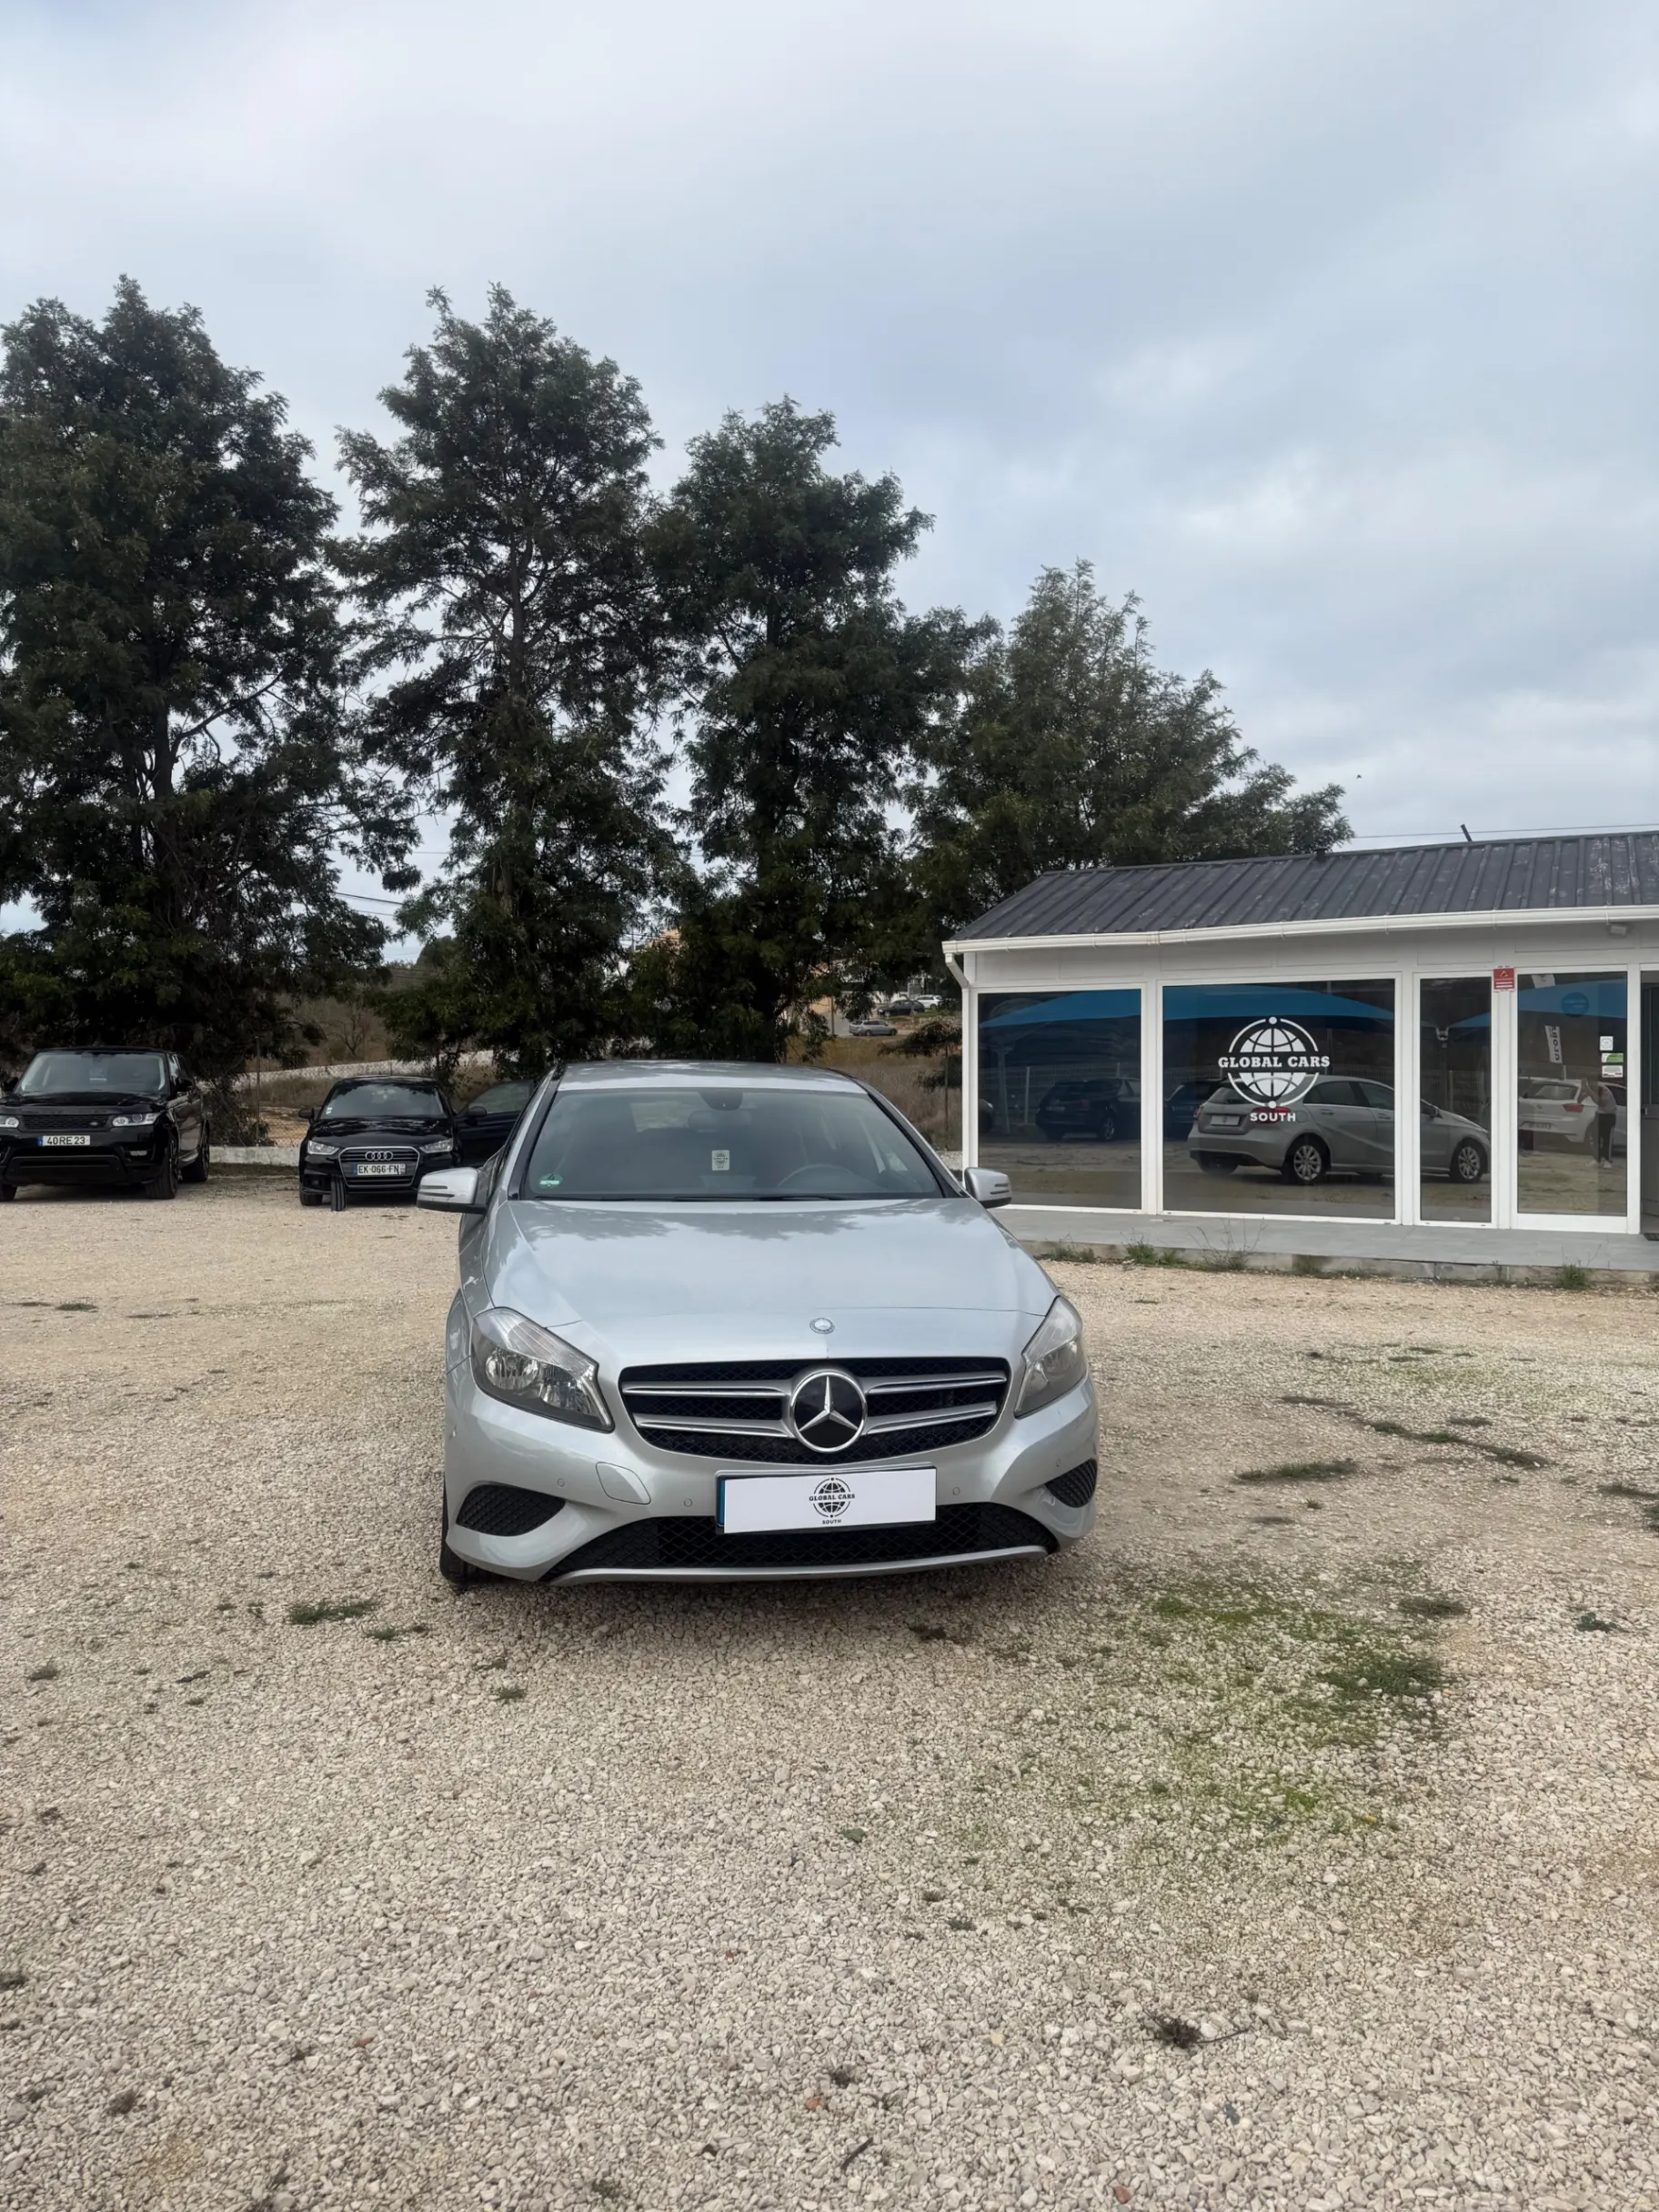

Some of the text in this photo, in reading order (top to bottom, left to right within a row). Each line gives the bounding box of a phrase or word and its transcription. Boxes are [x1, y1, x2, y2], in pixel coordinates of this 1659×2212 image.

[1218, 1056, 1330, 1068] GLOBAL CARS
[1250, 1112, 1296, 1121] SOUTH
